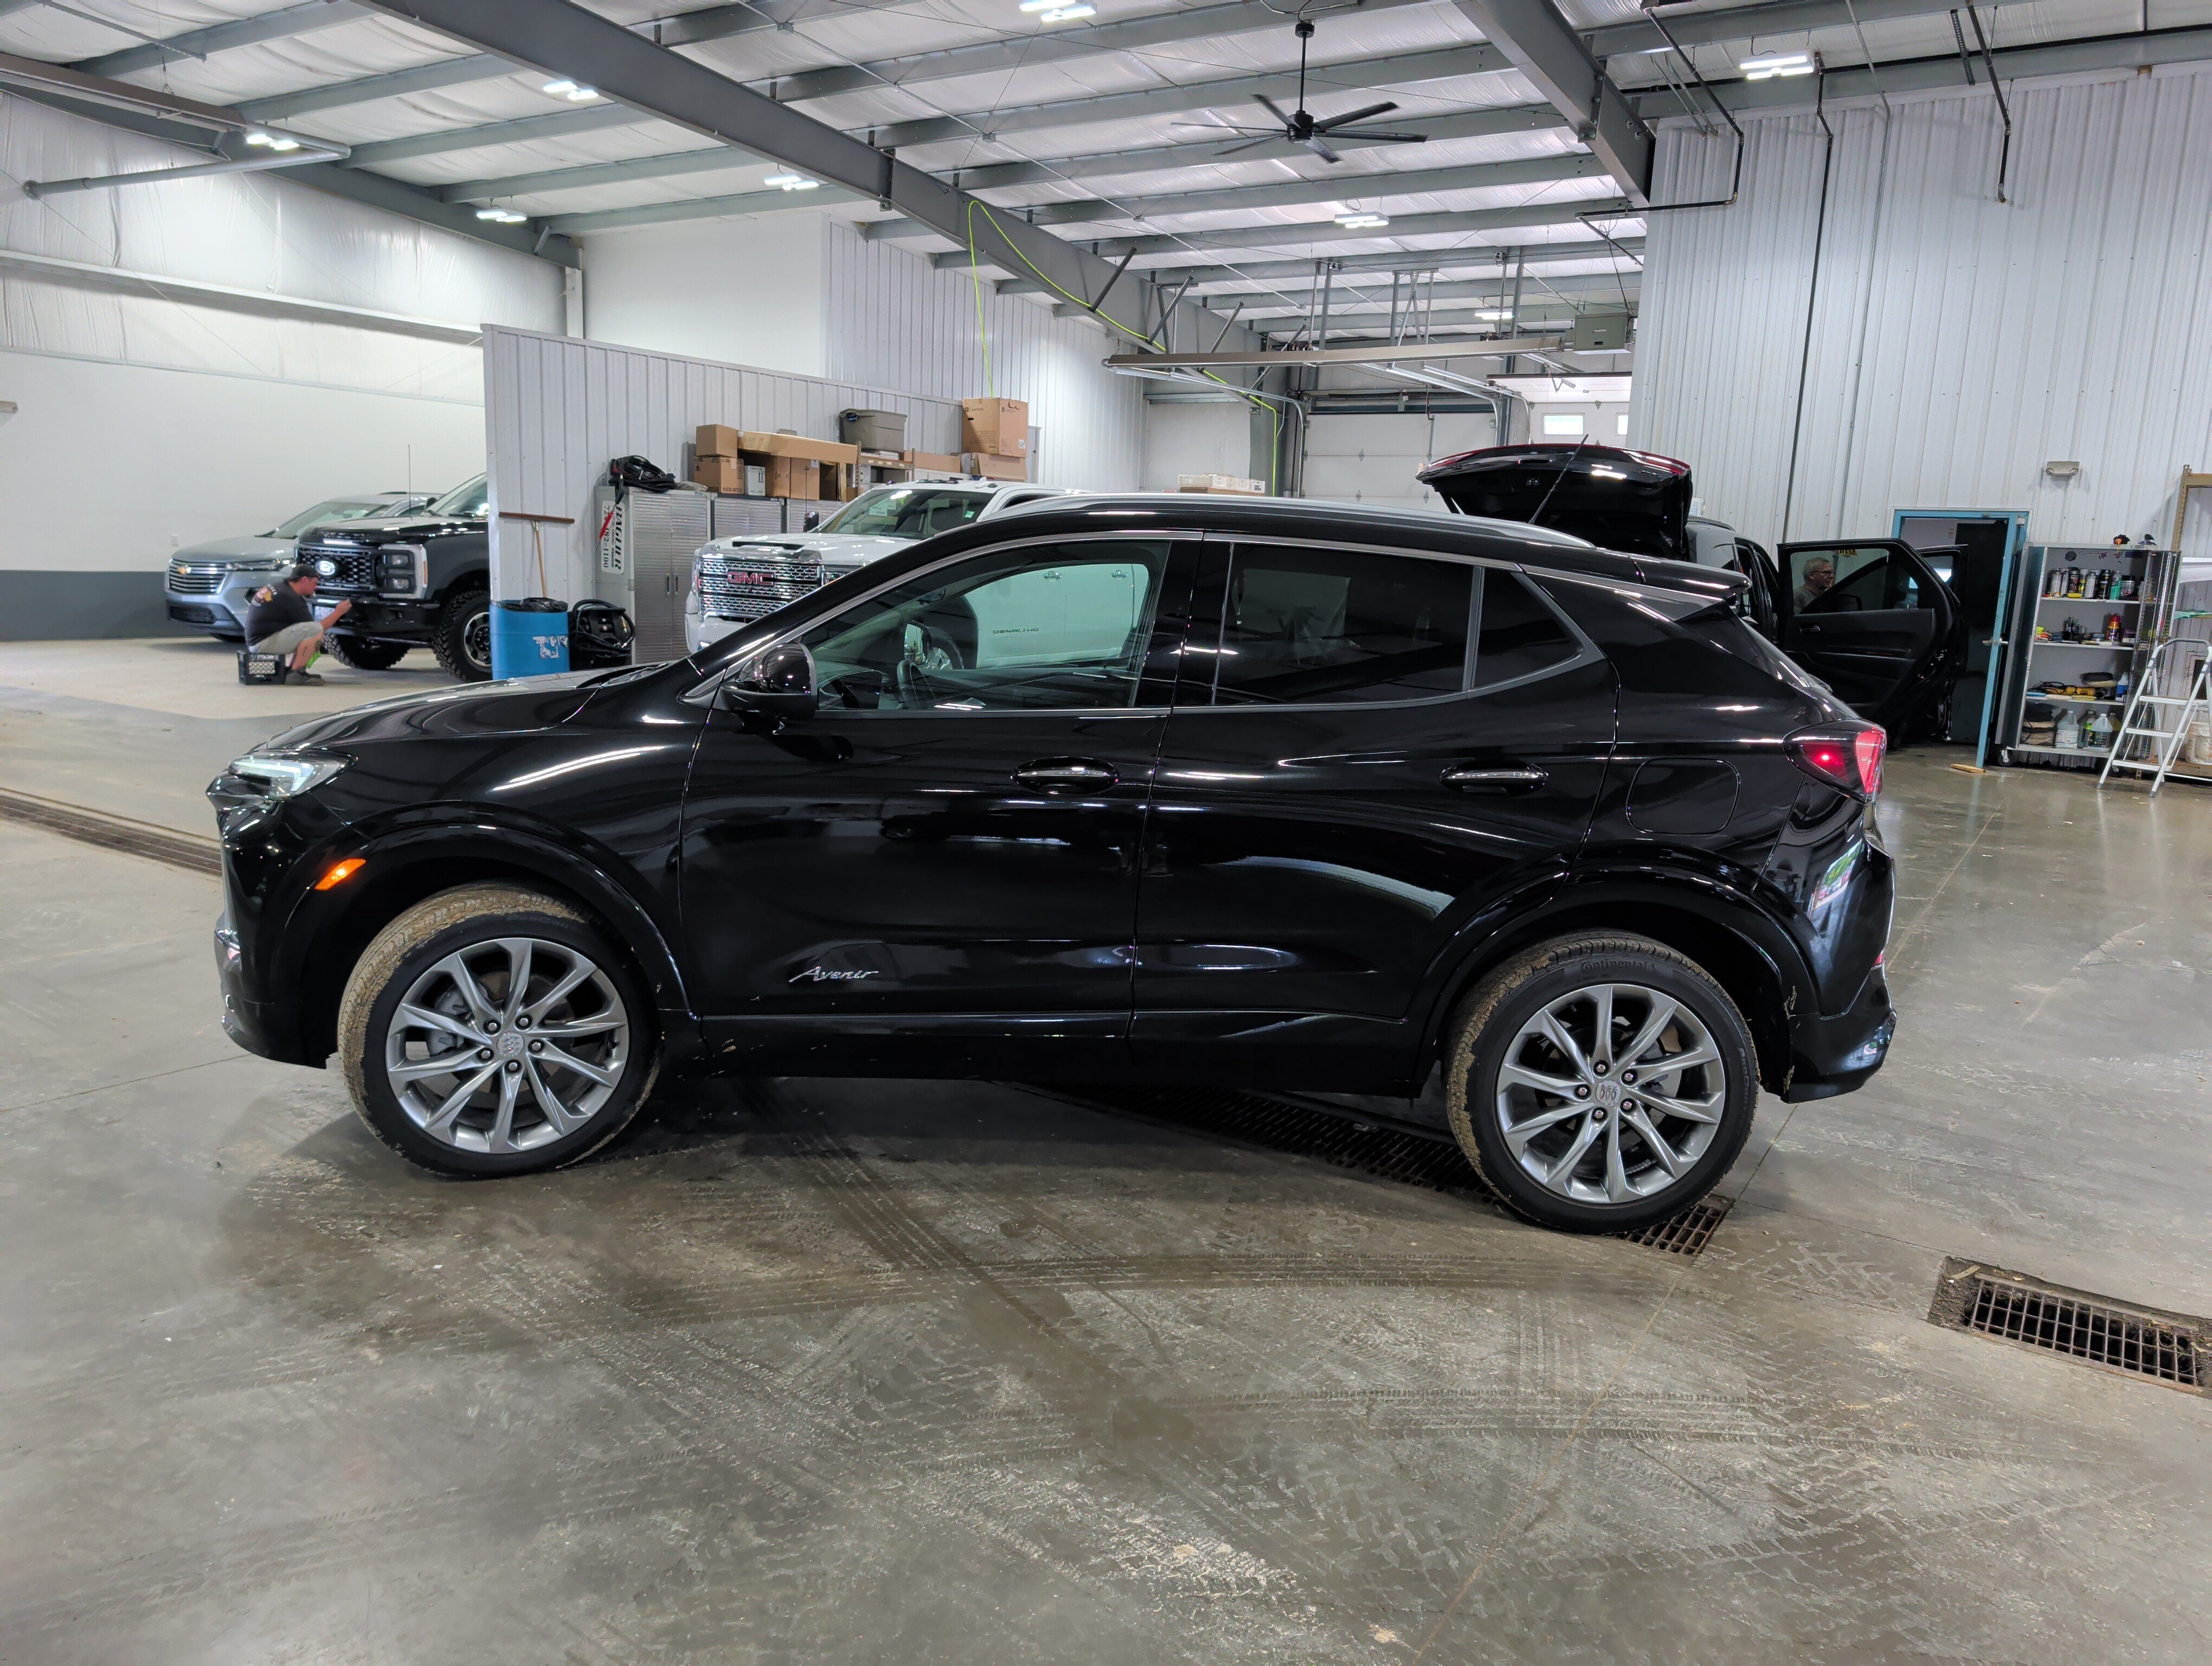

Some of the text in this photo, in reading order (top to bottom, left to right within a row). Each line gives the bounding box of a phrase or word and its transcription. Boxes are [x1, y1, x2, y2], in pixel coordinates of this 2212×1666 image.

[728, 571, 774, 586] GMC
[788, 965, 879, 983] Avenir
[1580, 959, 1648, 974] Continental
